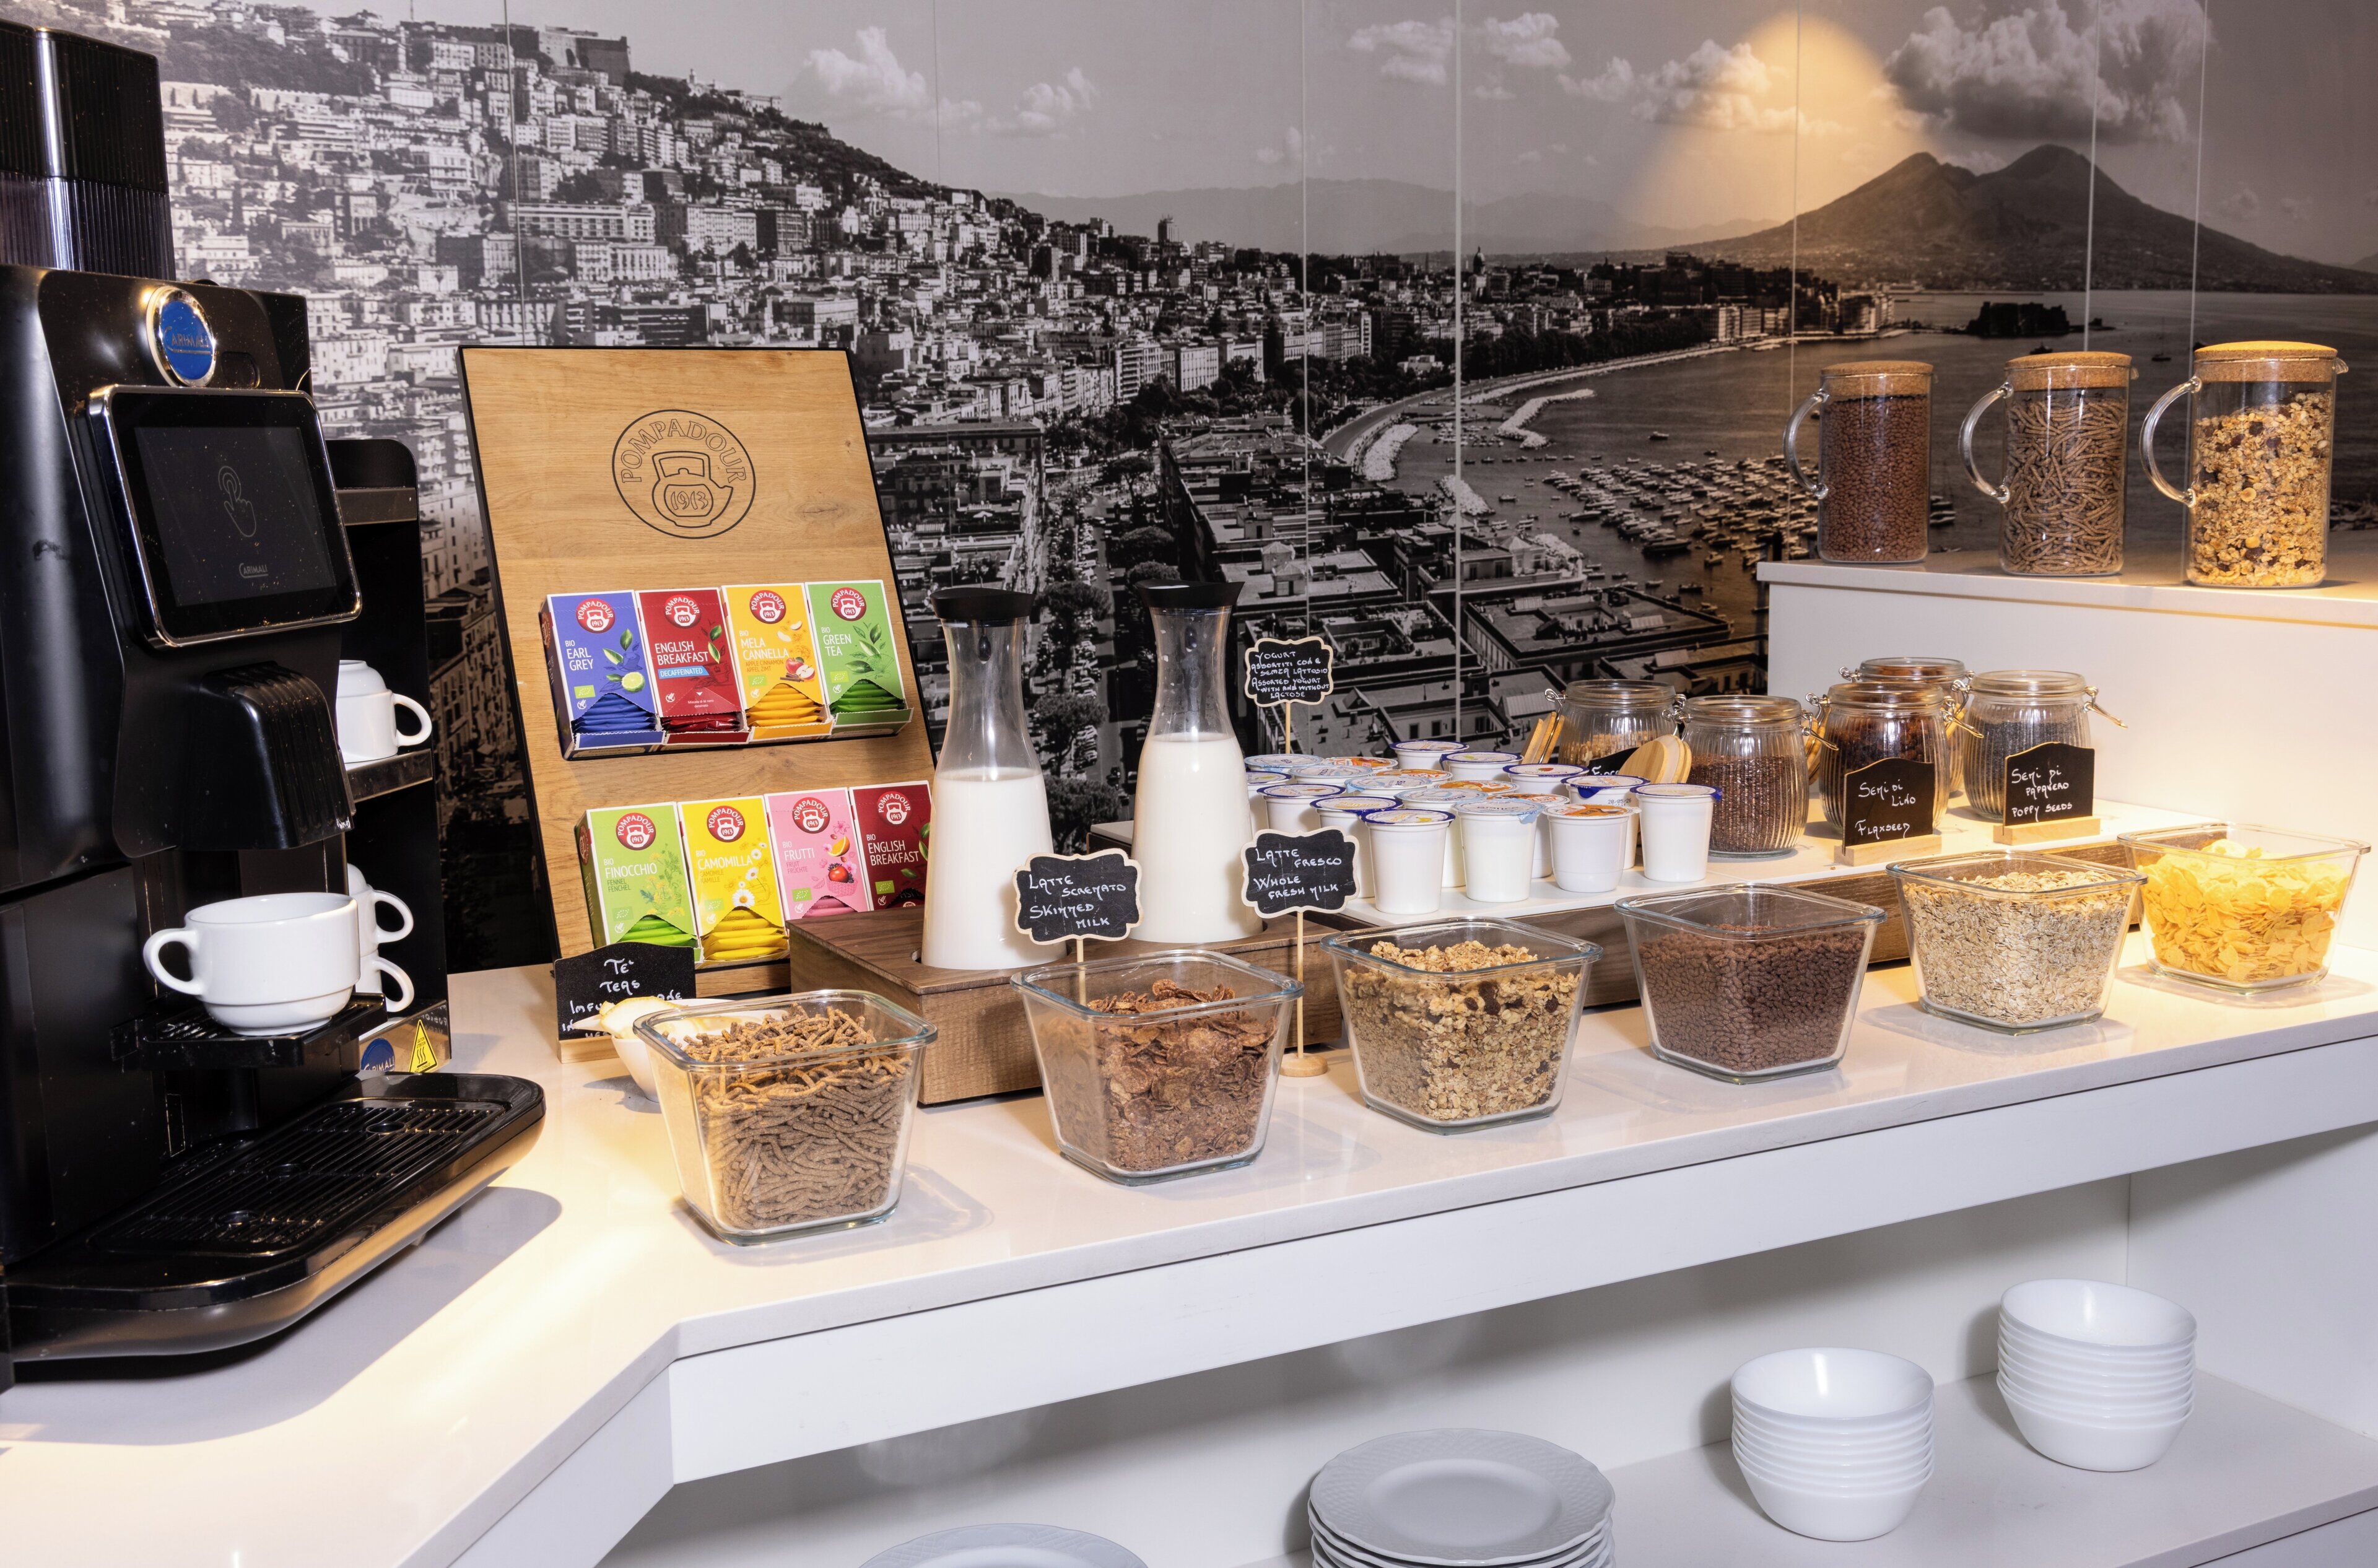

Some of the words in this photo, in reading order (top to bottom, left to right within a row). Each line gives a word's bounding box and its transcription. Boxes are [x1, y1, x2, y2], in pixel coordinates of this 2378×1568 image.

[621, 419, 747, 484] POMPADOUR
[670, 490, 709, 511] 1913
[238, 562, 269, 578] CARIMALI
[665, 596, 700, 616] POMPADOUR
[751, 592, 785, 611] POMPADOUR
[832, 589, 866, 608] POMPADOUR
[577, 600, 614, 620] POMPADOUR
[565, 640, 575, 648] BIO
[740, 637, 766, 649] MELA
[823, 634, 852, 645] GREEN
[567, 648, 592, 660] EARL
[655, 640, 695, 655] ENGLISH
[743, 648, 790, 661] CANNELLA
[825, 646, 843, 657] TEA
[569, 658, 594, 671] GREY
[657, 651, 708, 666] BREAKFAST
[1255, 651, 1296, 667] YOGURT
[660, 668, 703, 677] DECAFFEINATED
[1251, 661, 1292, 674] ASSORTITI
[1293, 668, 1328, 678] LATTOSIO
[1252, 677, 1289, 690] ASSORTED
[1292, 678, 1320, 686] YOGURT
[1270, 692, 1305, 700] LACTOSE
[794, 799, 829, 820] POMPADOUR
[878, 793, 911, 813] POMPADOUR
[708, 808, 744, 829] POMPADOUR
[2011, 805, 2039, 822] POPPY
[2045, 803, 2073, 812] SEEDS
[617, 815, 654, 837] POMPADOUR
[866, 834, 876, 842] BIO
[784, 848, 816, 861] FRUTTI
[868, 840, 905, 854] ENGLISH
[604, 858, 614, 866] BIO
[697, 855, 753, 871] CAMOMILLA
[870, 851, 920, 866] BREAKFAST
[1255, 848, 1300, 868] LATTE
[1294, 858, 1342, 868] FRESCO
[605, 863, 658, 878] FINOCCHIO
[608, 884, 631, 892] FENCHEL
[1029, 874, 1074, 895] LATTE
[1253, 874, 1301, 891] WHOLE
[1061, 884, 1126, 901] SCREMATO
[1268, 887, 1305, 900] FRESH
[1310, 884, 1339, 901] MILK
[1029, 903, 1094, 919] SKIMMED
[1075, 917, 1110, 929] MILK
